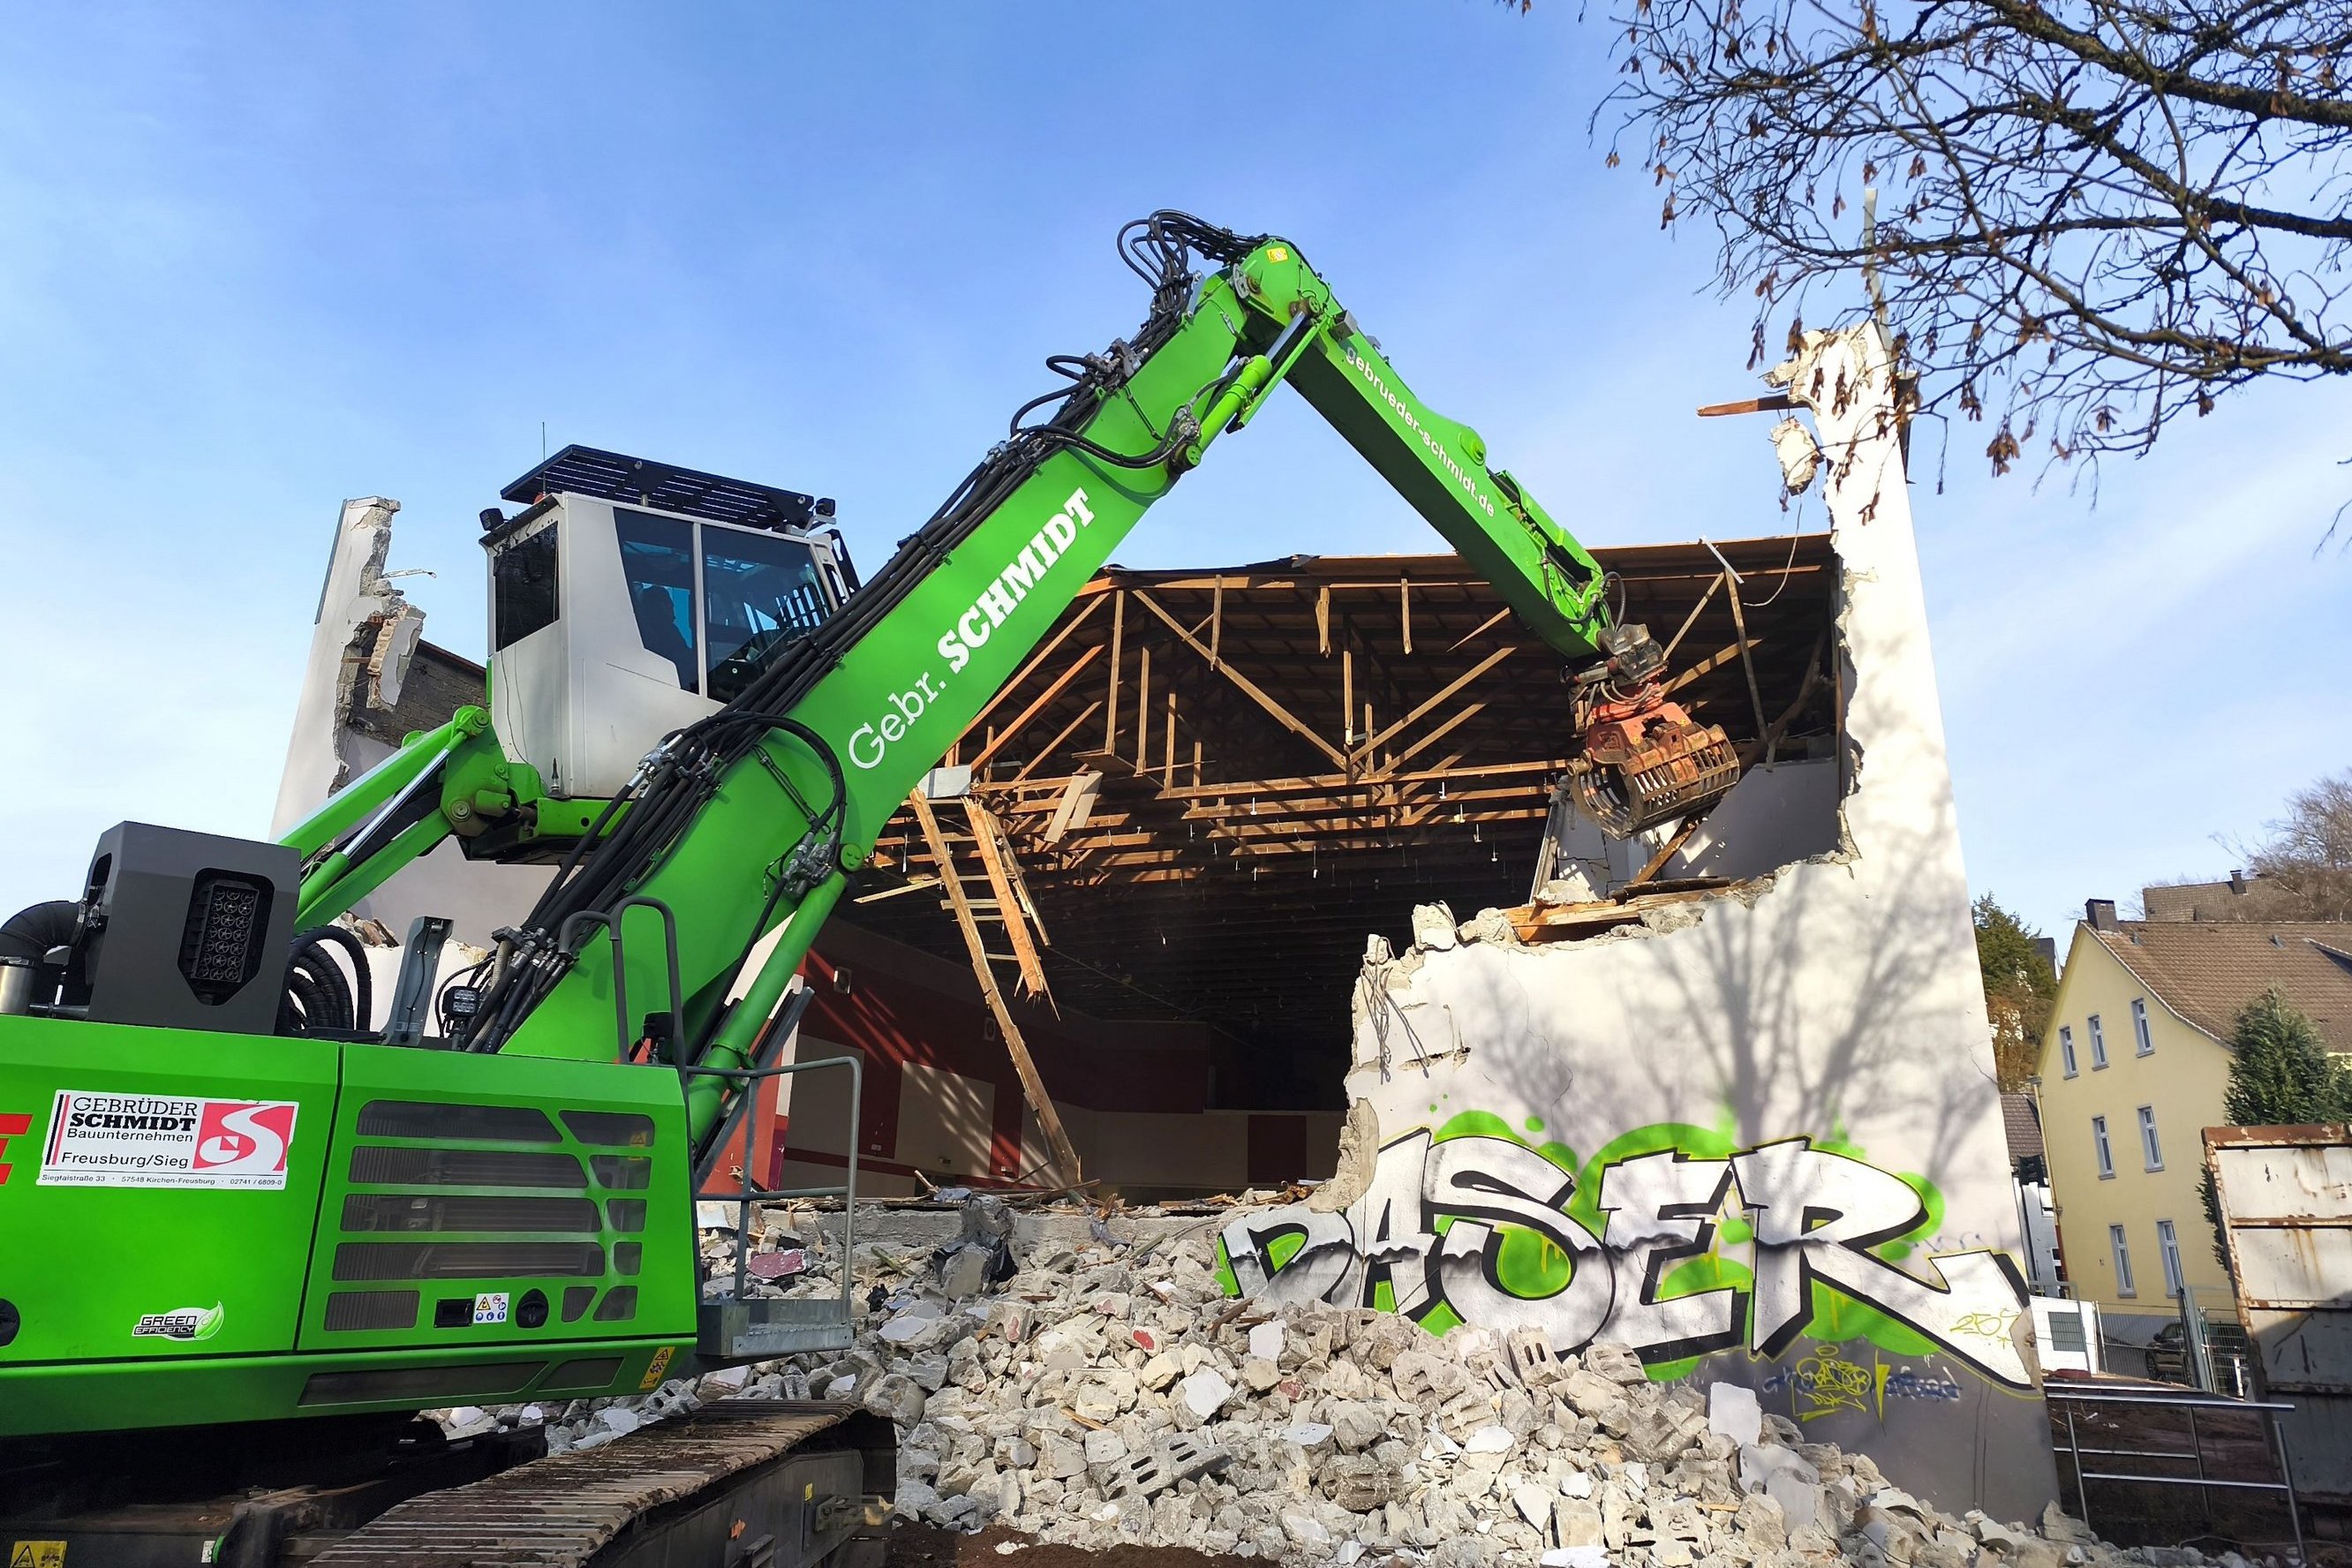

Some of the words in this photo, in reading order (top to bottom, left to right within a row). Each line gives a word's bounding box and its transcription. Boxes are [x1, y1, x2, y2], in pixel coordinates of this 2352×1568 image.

[1346, 346, 1495, 518] gebrueder-schmidt.de
[848, 670, 947, 770] Gebr.
[937, 486, 1096, 674] SCHMIDT
[73, 1097, 198, 1116] GEBRÜDER
[70, 1113, 196, 1131] SCHMIDT
[67, 1128, 193, 1142] Bauunternehmen
[62, 1152, 189, 1169] Freusburg/Sieg
[141, 1315, 197, 1326] GREEN
[135, 1325, 194, 1334] EFFICIENCY
